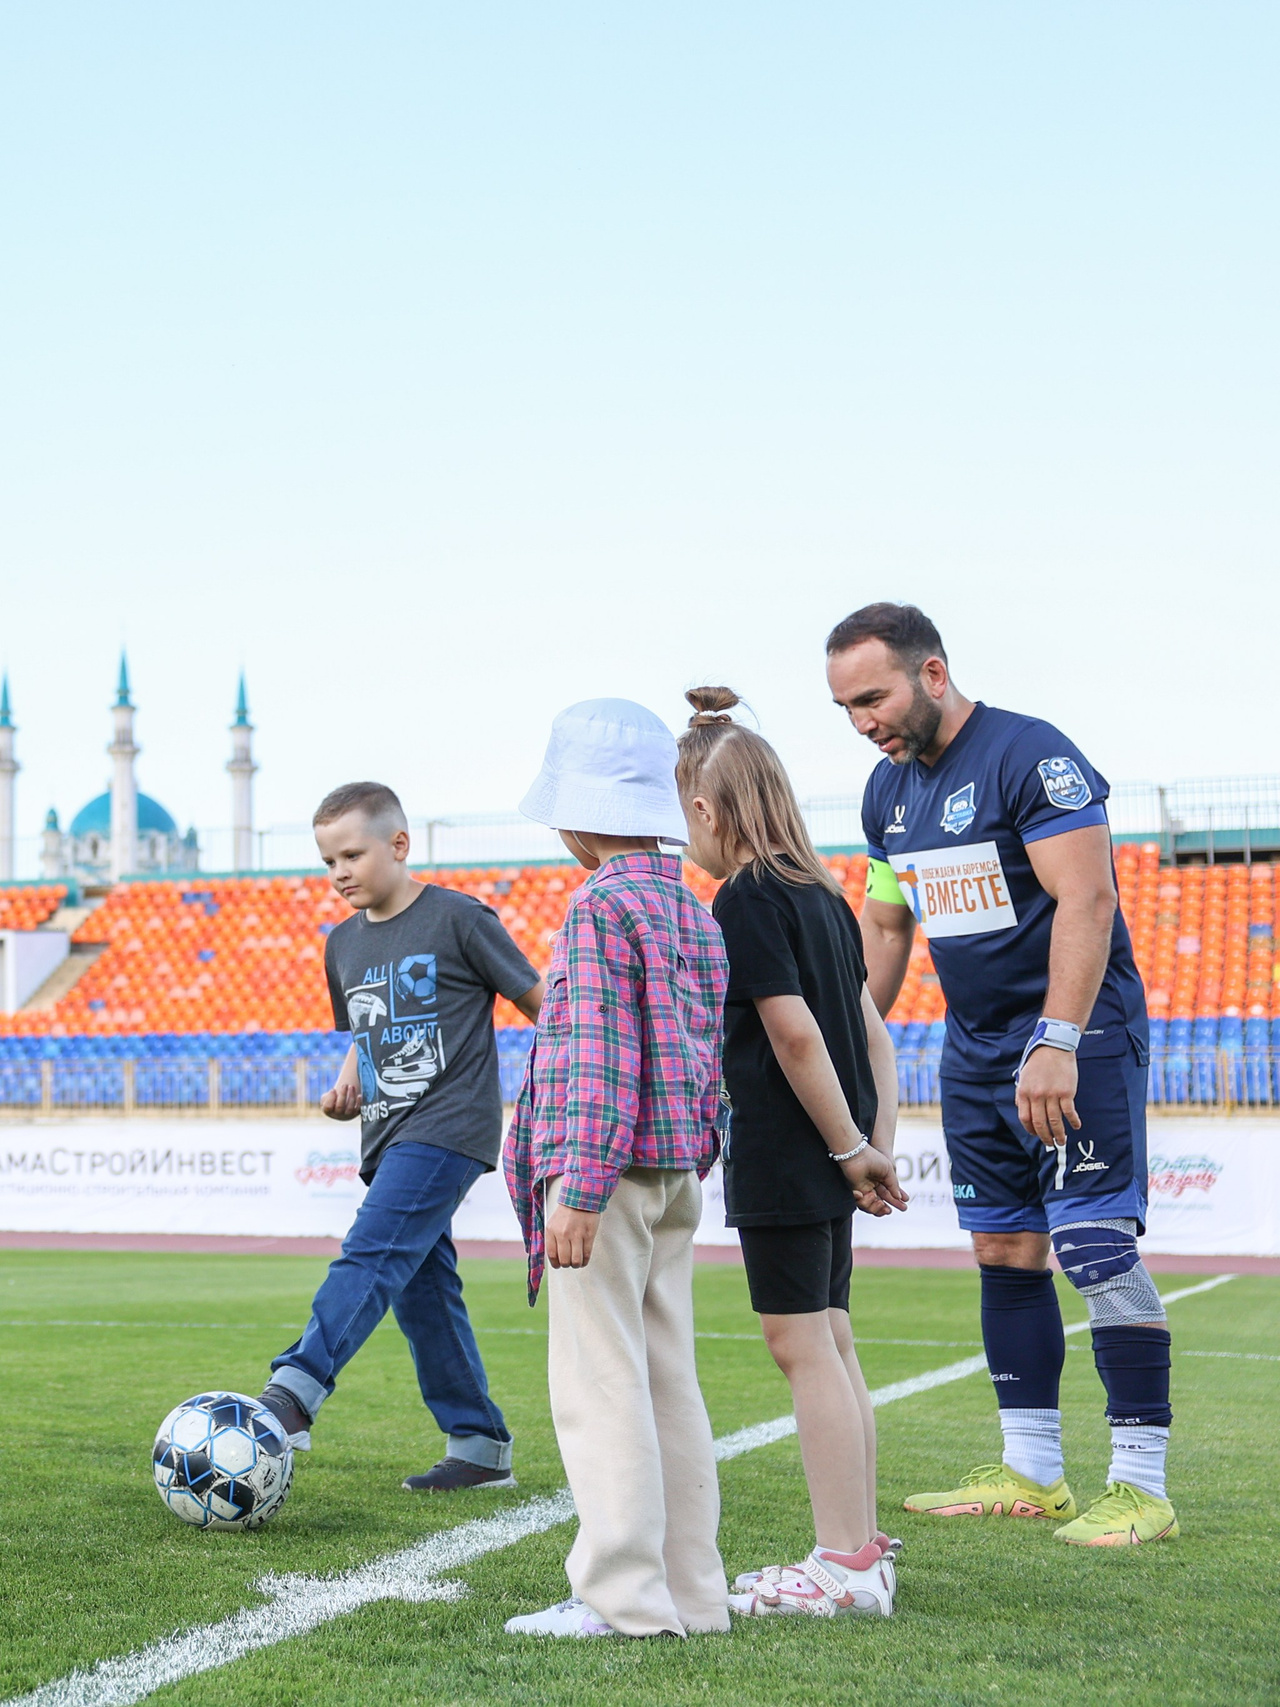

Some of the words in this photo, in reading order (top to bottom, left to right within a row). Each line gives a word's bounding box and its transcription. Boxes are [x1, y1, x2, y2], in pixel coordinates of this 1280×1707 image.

[1046, 773, 1084, 792] MFL
[962, 859, 999, 875] БОРЕМСЯ
[925, 873, 1009, 916] ВМЕСТЕ
[363, 965, 387, 984] ALL
[380, 1021, 438, 1045] ABOUT
[1072, 1161, 1110, 1173] JÖGEL
[989, 1372, 1020, 1382] GEL
